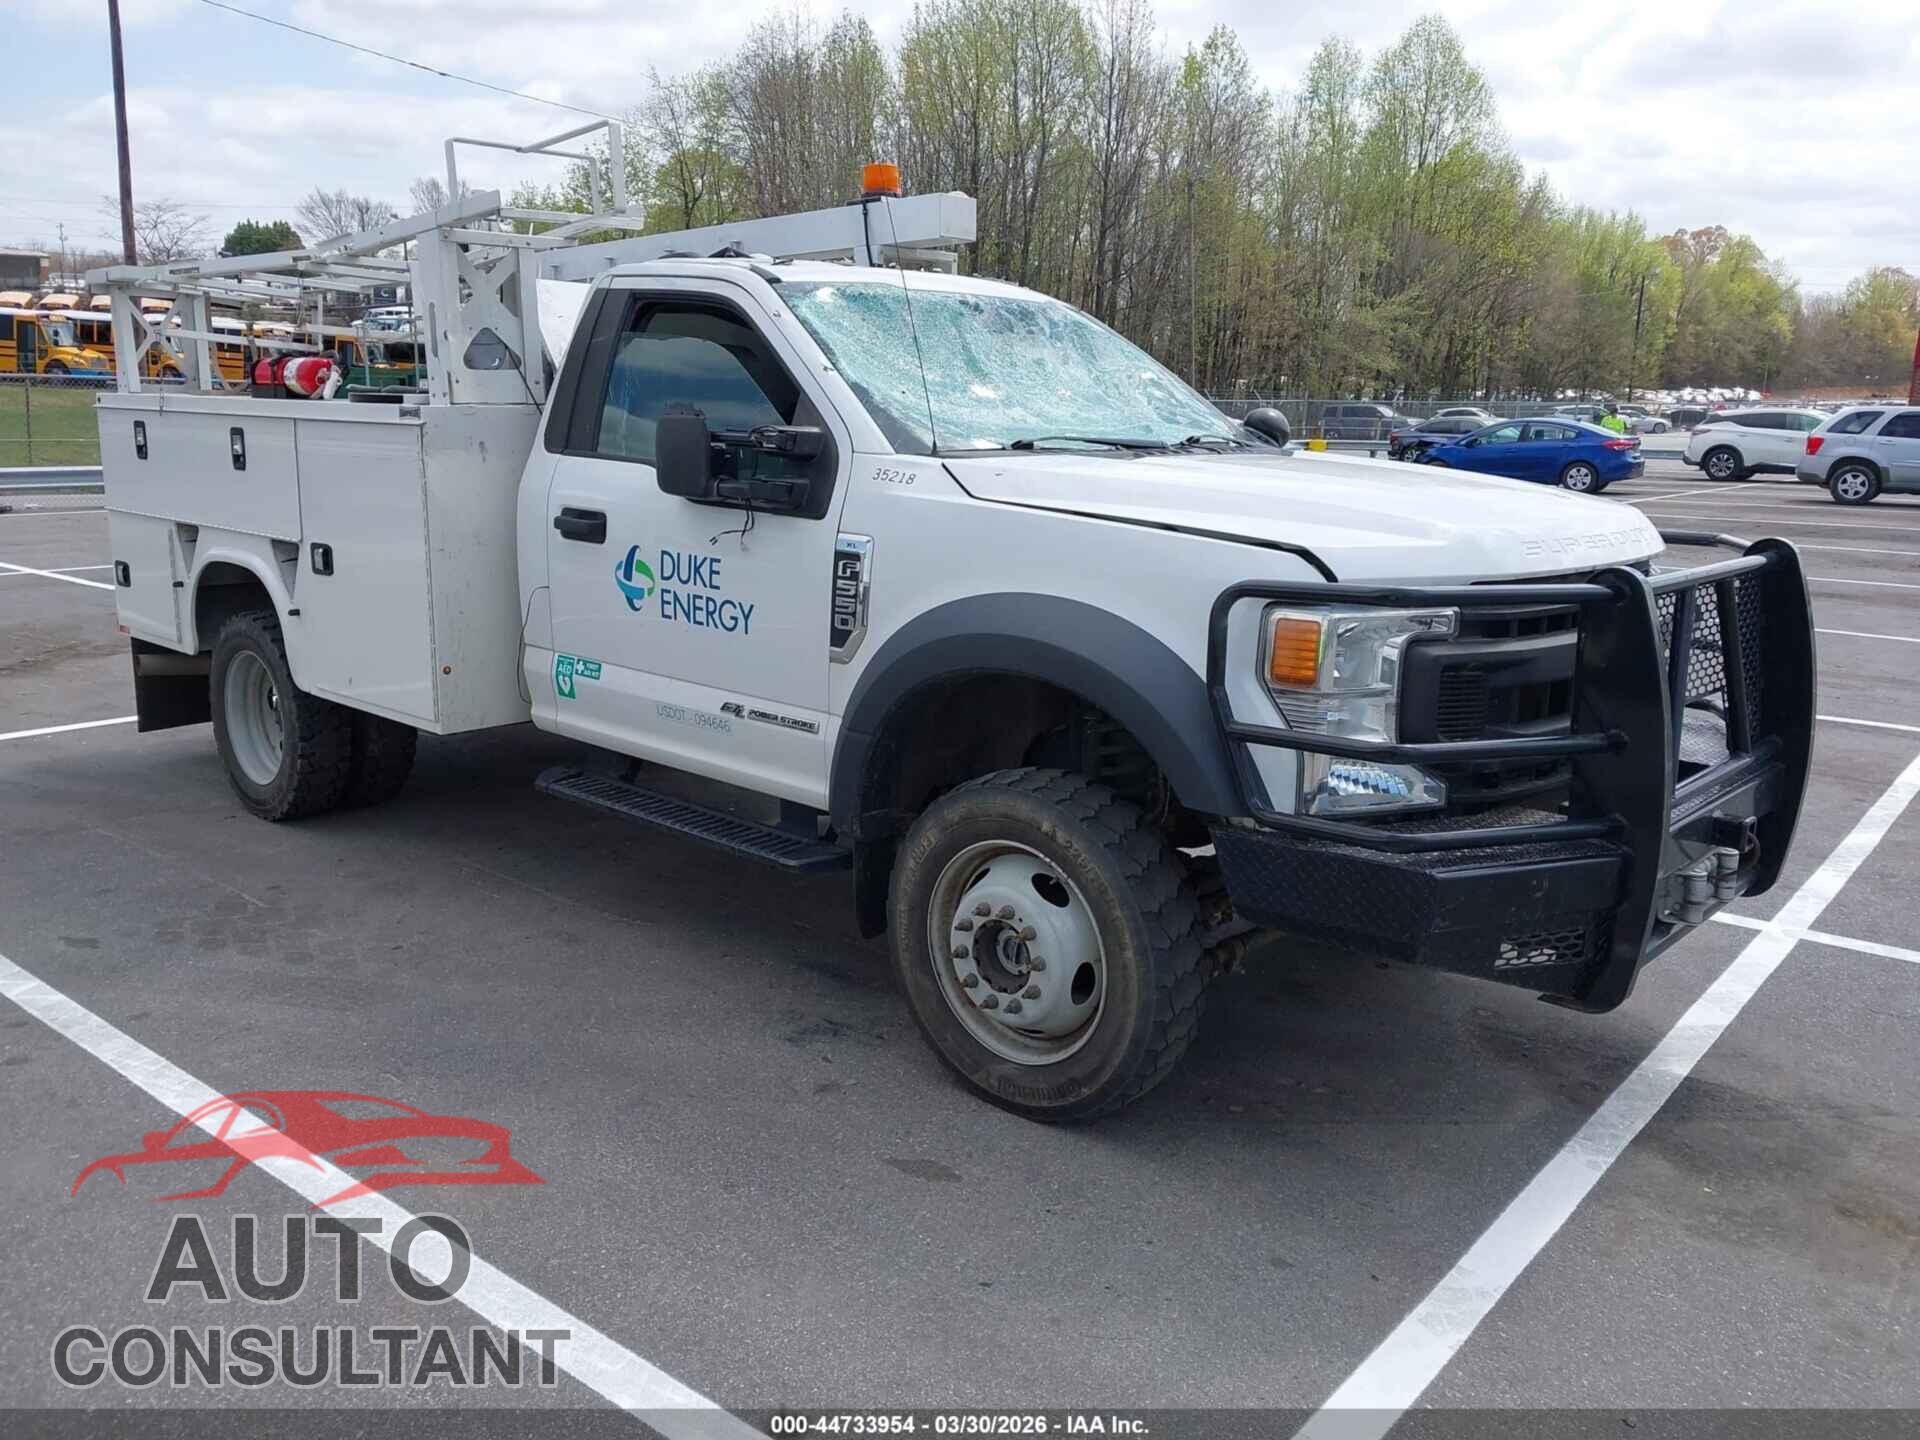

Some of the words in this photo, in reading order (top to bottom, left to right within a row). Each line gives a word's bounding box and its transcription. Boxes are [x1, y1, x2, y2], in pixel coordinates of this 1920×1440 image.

[872, 467, 916, 485] 35218
[660, 550, 721, 590] DUKE
[660, 588, 754, 635] ENERGY
[780, 716, 816, 729] STROKE
